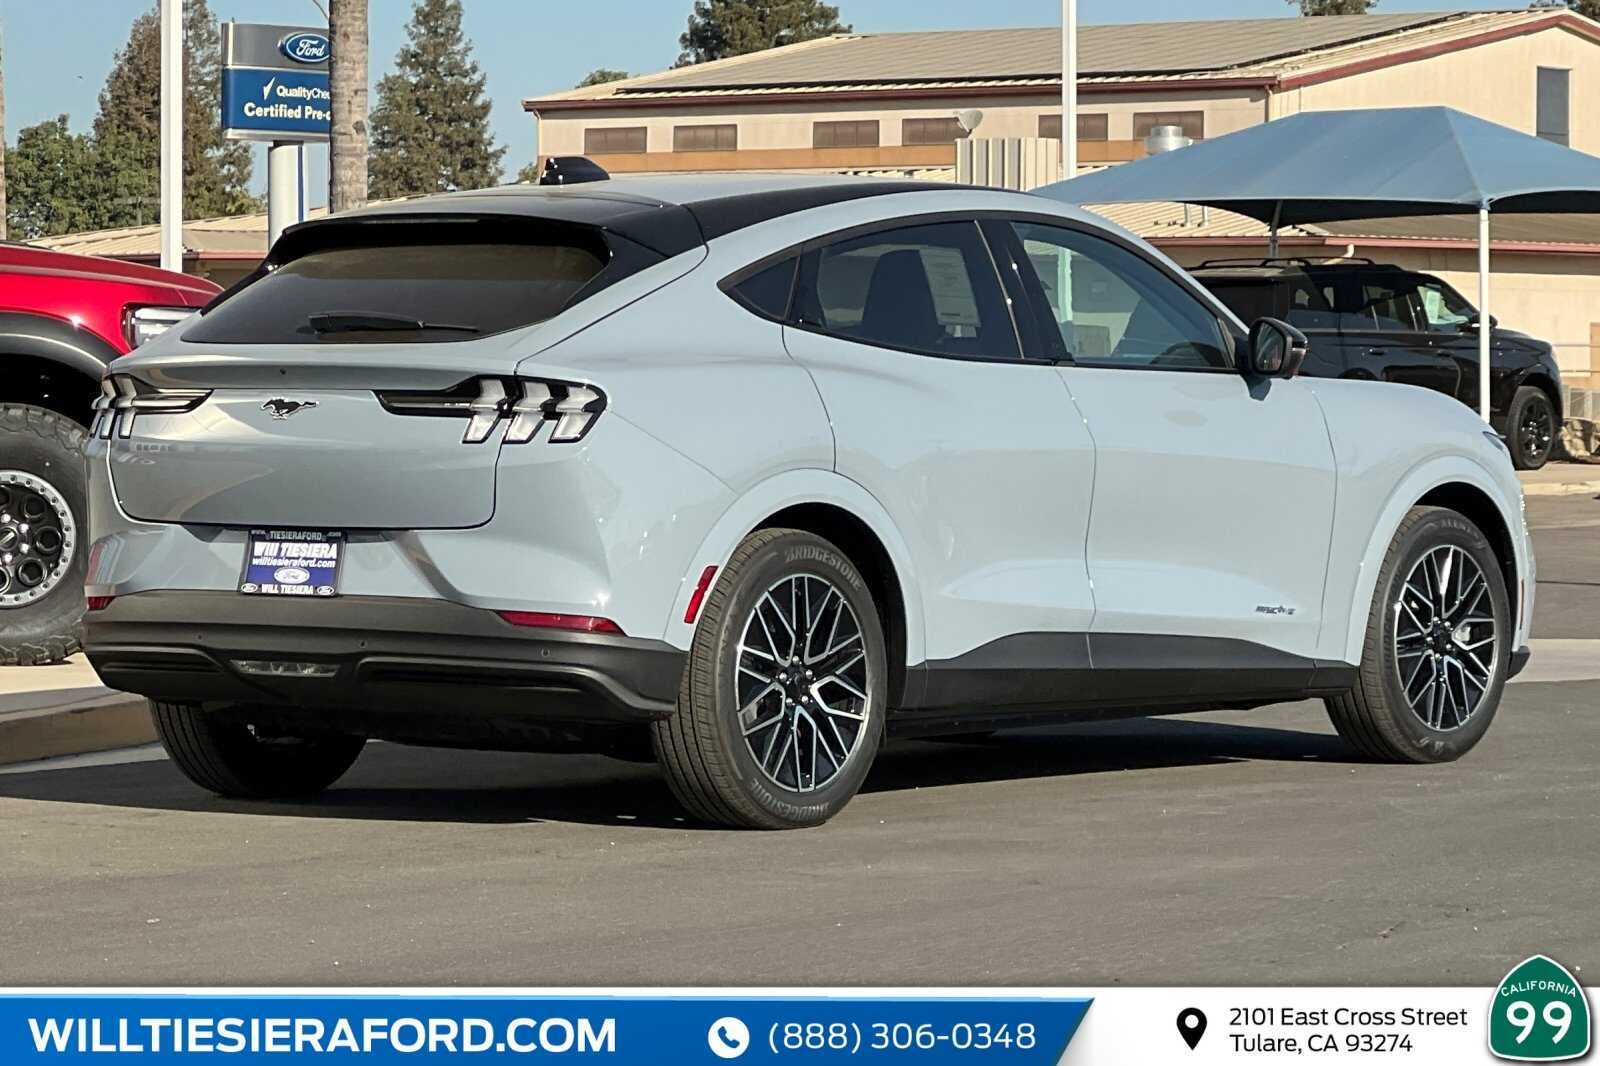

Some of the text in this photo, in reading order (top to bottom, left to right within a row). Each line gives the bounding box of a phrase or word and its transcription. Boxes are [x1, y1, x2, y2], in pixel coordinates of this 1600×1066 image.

[296, 39, 325, 56] Ford
[243, 102, 302, 119] Certified
[280, 542, 338, 559] TIESIERA
[252, 556, 336, 569] willtiesieraford.com
[785, 545, 862, 591] BRIDGESTONE
[261, 583, 279, 594] WILL
